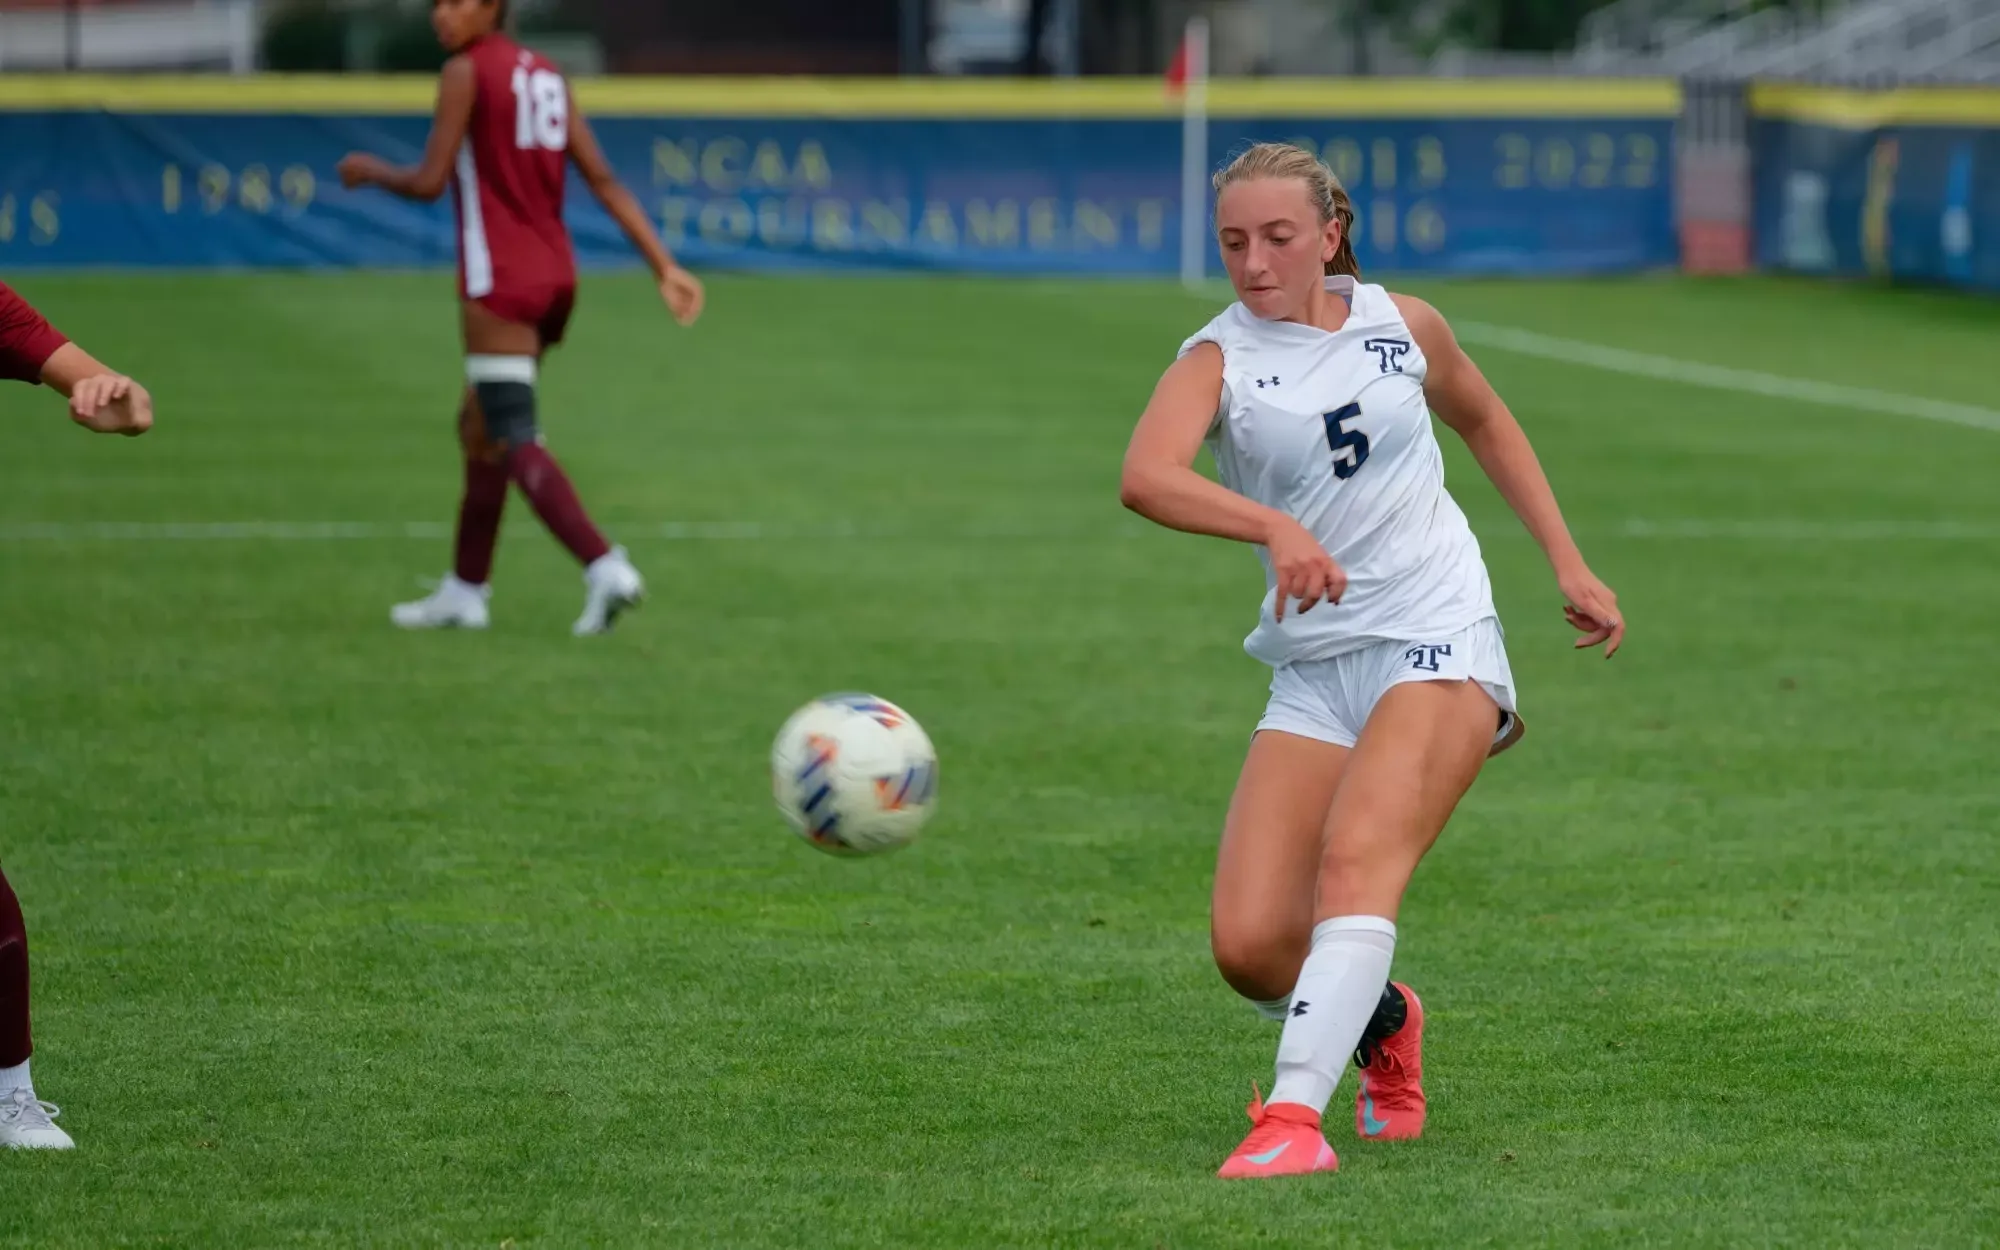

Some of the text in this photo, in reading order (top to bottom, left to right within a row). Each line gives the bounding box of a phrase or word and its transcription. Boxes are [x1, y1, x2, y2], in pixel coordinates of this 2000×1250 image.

[511, 66, 568, 151] 18
[652, 135, 833, 189] NCAA
[1286, 132, 1659, 190] 013 2022
[162, 162, 316, 217] 1989
[659, 196, 1166, 251] TOURNAMENT
[1350, 198, 1446, 254] 16
[1321, 401, 1370, 481] 5
